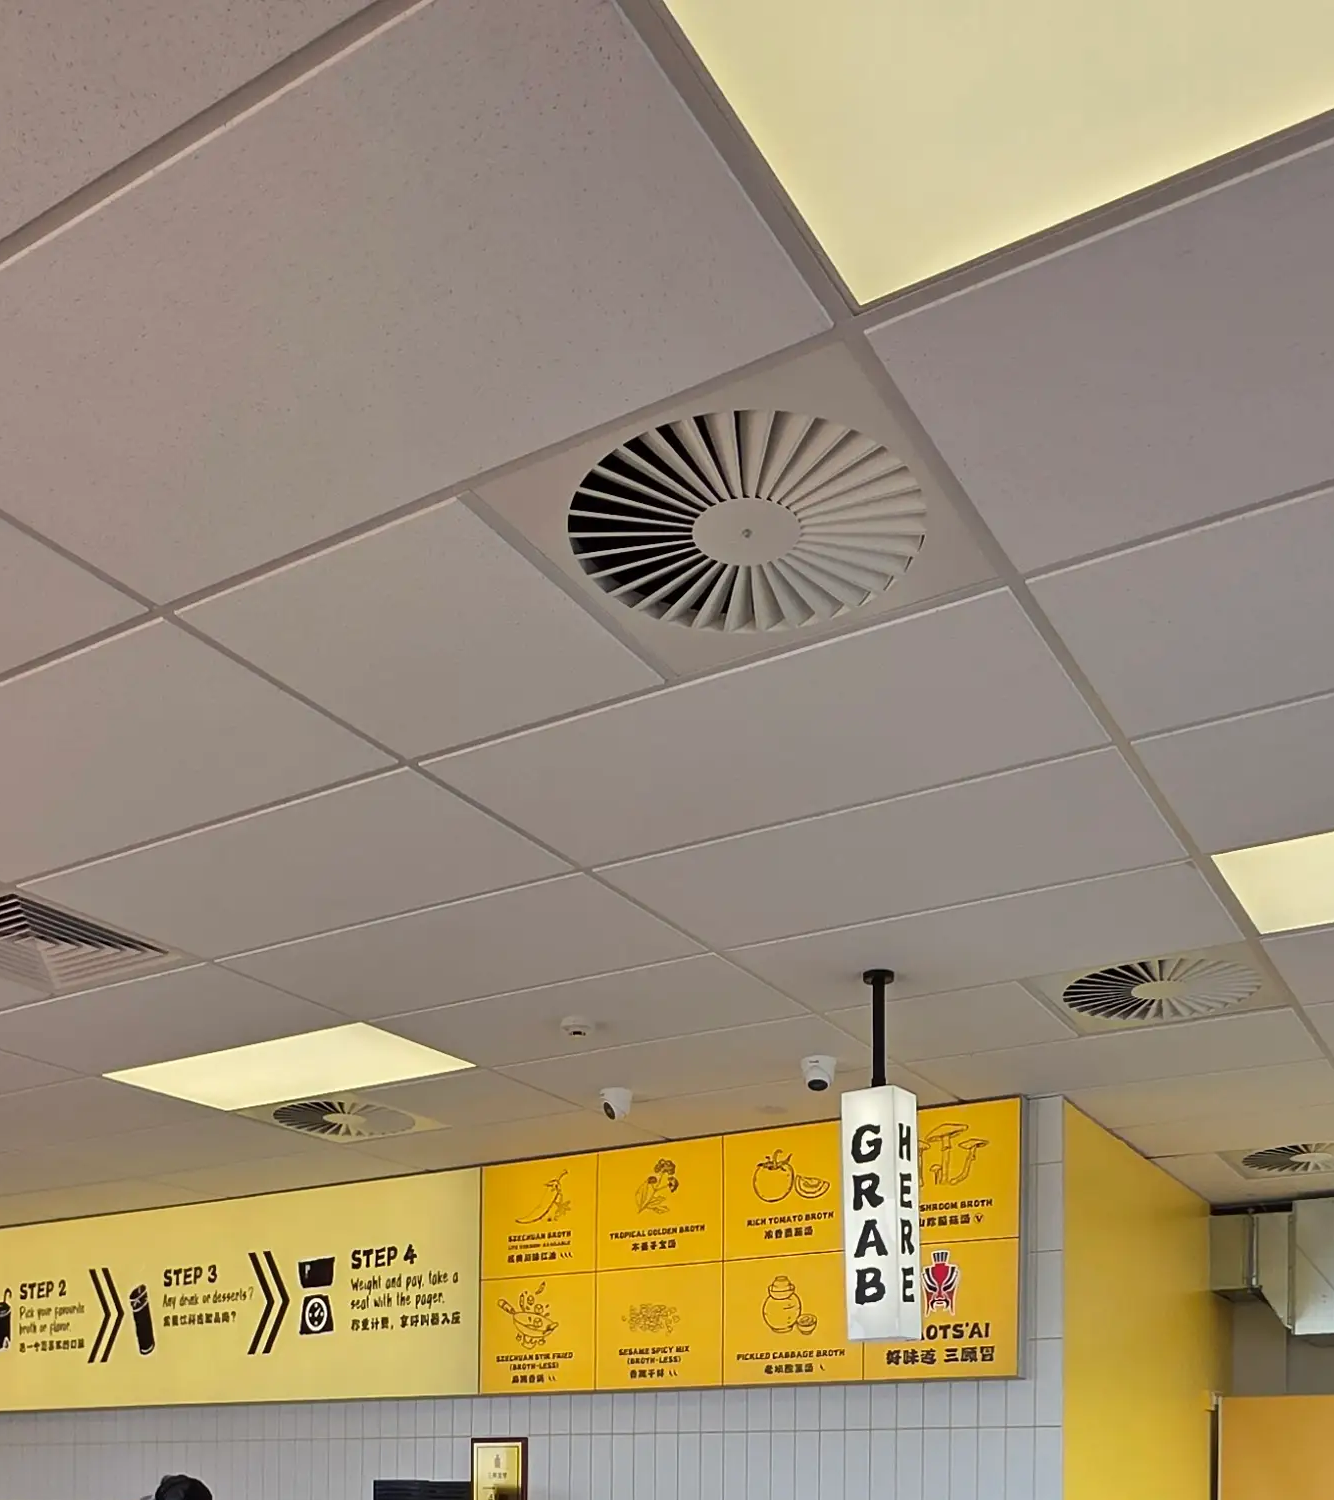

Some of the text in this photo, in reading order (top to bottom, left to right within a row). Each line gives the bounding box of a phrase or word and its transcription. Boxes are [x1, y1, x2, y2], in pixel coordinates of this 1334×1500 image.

[898, 1122, 915, 1303] HERE
[919, 1198, 993, 1212] SHROOM BROTH
[747, 1211, 834, 1227] RICH TOMATO BROTH
[851, 1123, 889, 1305] GRAB
[508, 1230, 571, 1242] SZECHUAN BROTH
[609, 1224, 705, 1240] TROPICAL GOLDEN BROTH
[351, 1244, 417, 1270] STEP 4
[164, 1264, 217, 1287] STEP 3
[351, 1275, 381, 1295] Weight
[385, 1274, 401, 1290] and
[429, 1270, 449, 1286] take
[453, 1272, 459, 1284] a
[20, 1280, 67, 1300] STEP 2
[163, 1294, 176, 1309] Any
[203, 1294, 211, 1304] or
[351, 1294, 369, 1310] seat
[374, 1293, 392, 1308] with
[397, 1292, 411, 1306] the
[921, 1322, 989, 1340] OTS'AI
[496, 1354, 533, 1362] SZECHUAN
[552, 1352, 573, 1360] FRIED
[619, 1348, 649, 1356] SESAME
[651, 1346, 673, 1354] SPICY
[737, 1349, 845, 1360] PICKLED CABBAGE BROTH
